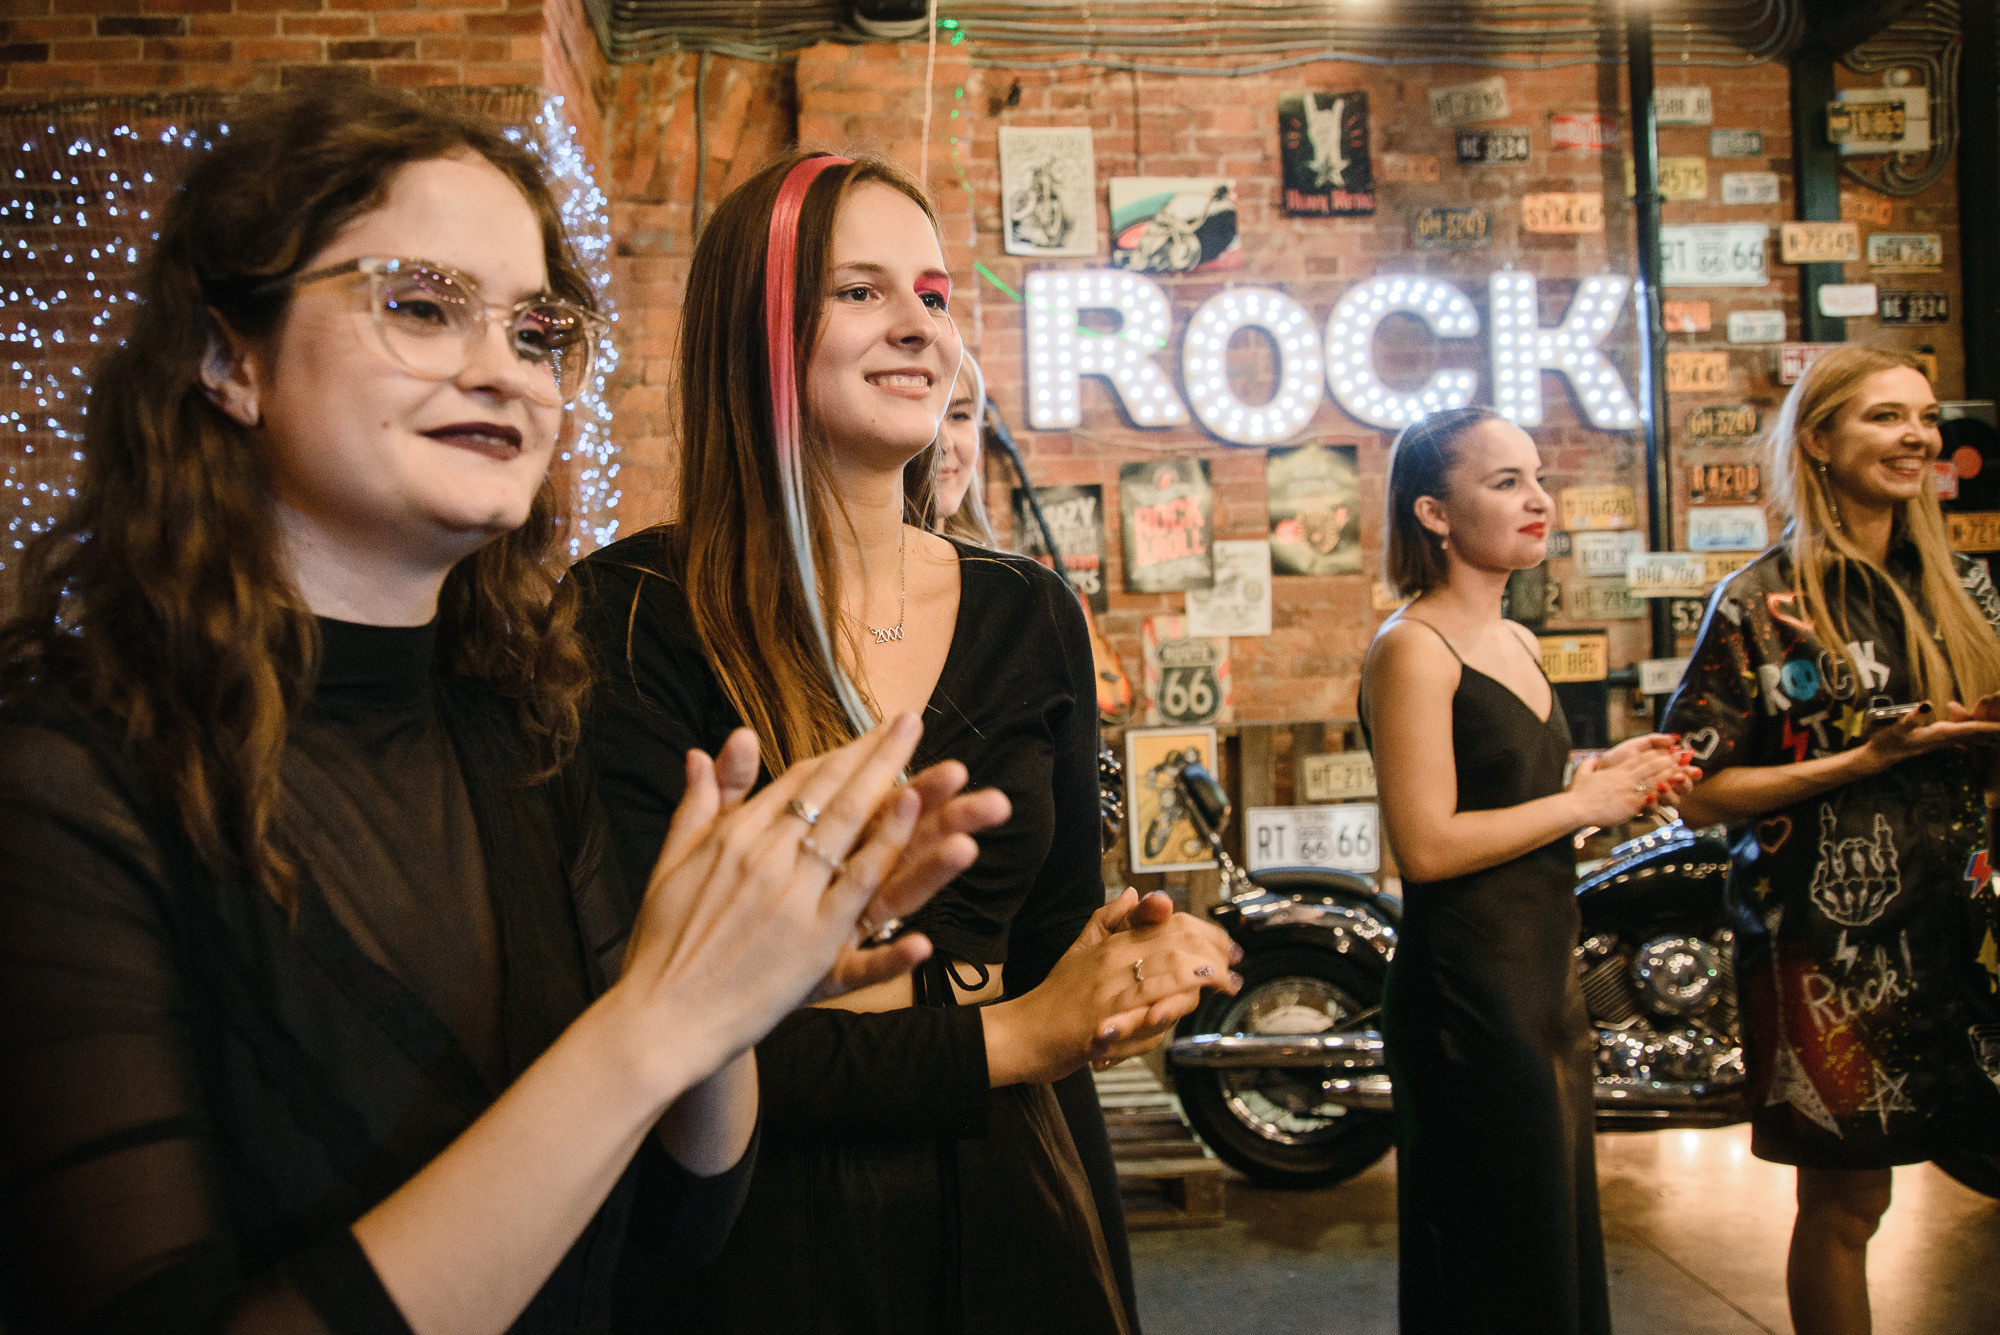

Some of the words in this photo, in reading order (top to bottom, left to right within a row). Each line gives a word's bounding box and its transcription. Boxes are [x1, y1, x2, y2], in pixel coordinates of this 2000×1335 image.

[1733, 240, 1764, 272] 66
[1024, 268, 1641, 446] ROCK
[874, 624, 905, 644] 2000
[1164, 668, 1215, 717] 66
[1257, 825, 1285, 861] RT
[1301, 840, 1328, 860] 66
[1338, 824, 1372, 857] 66
